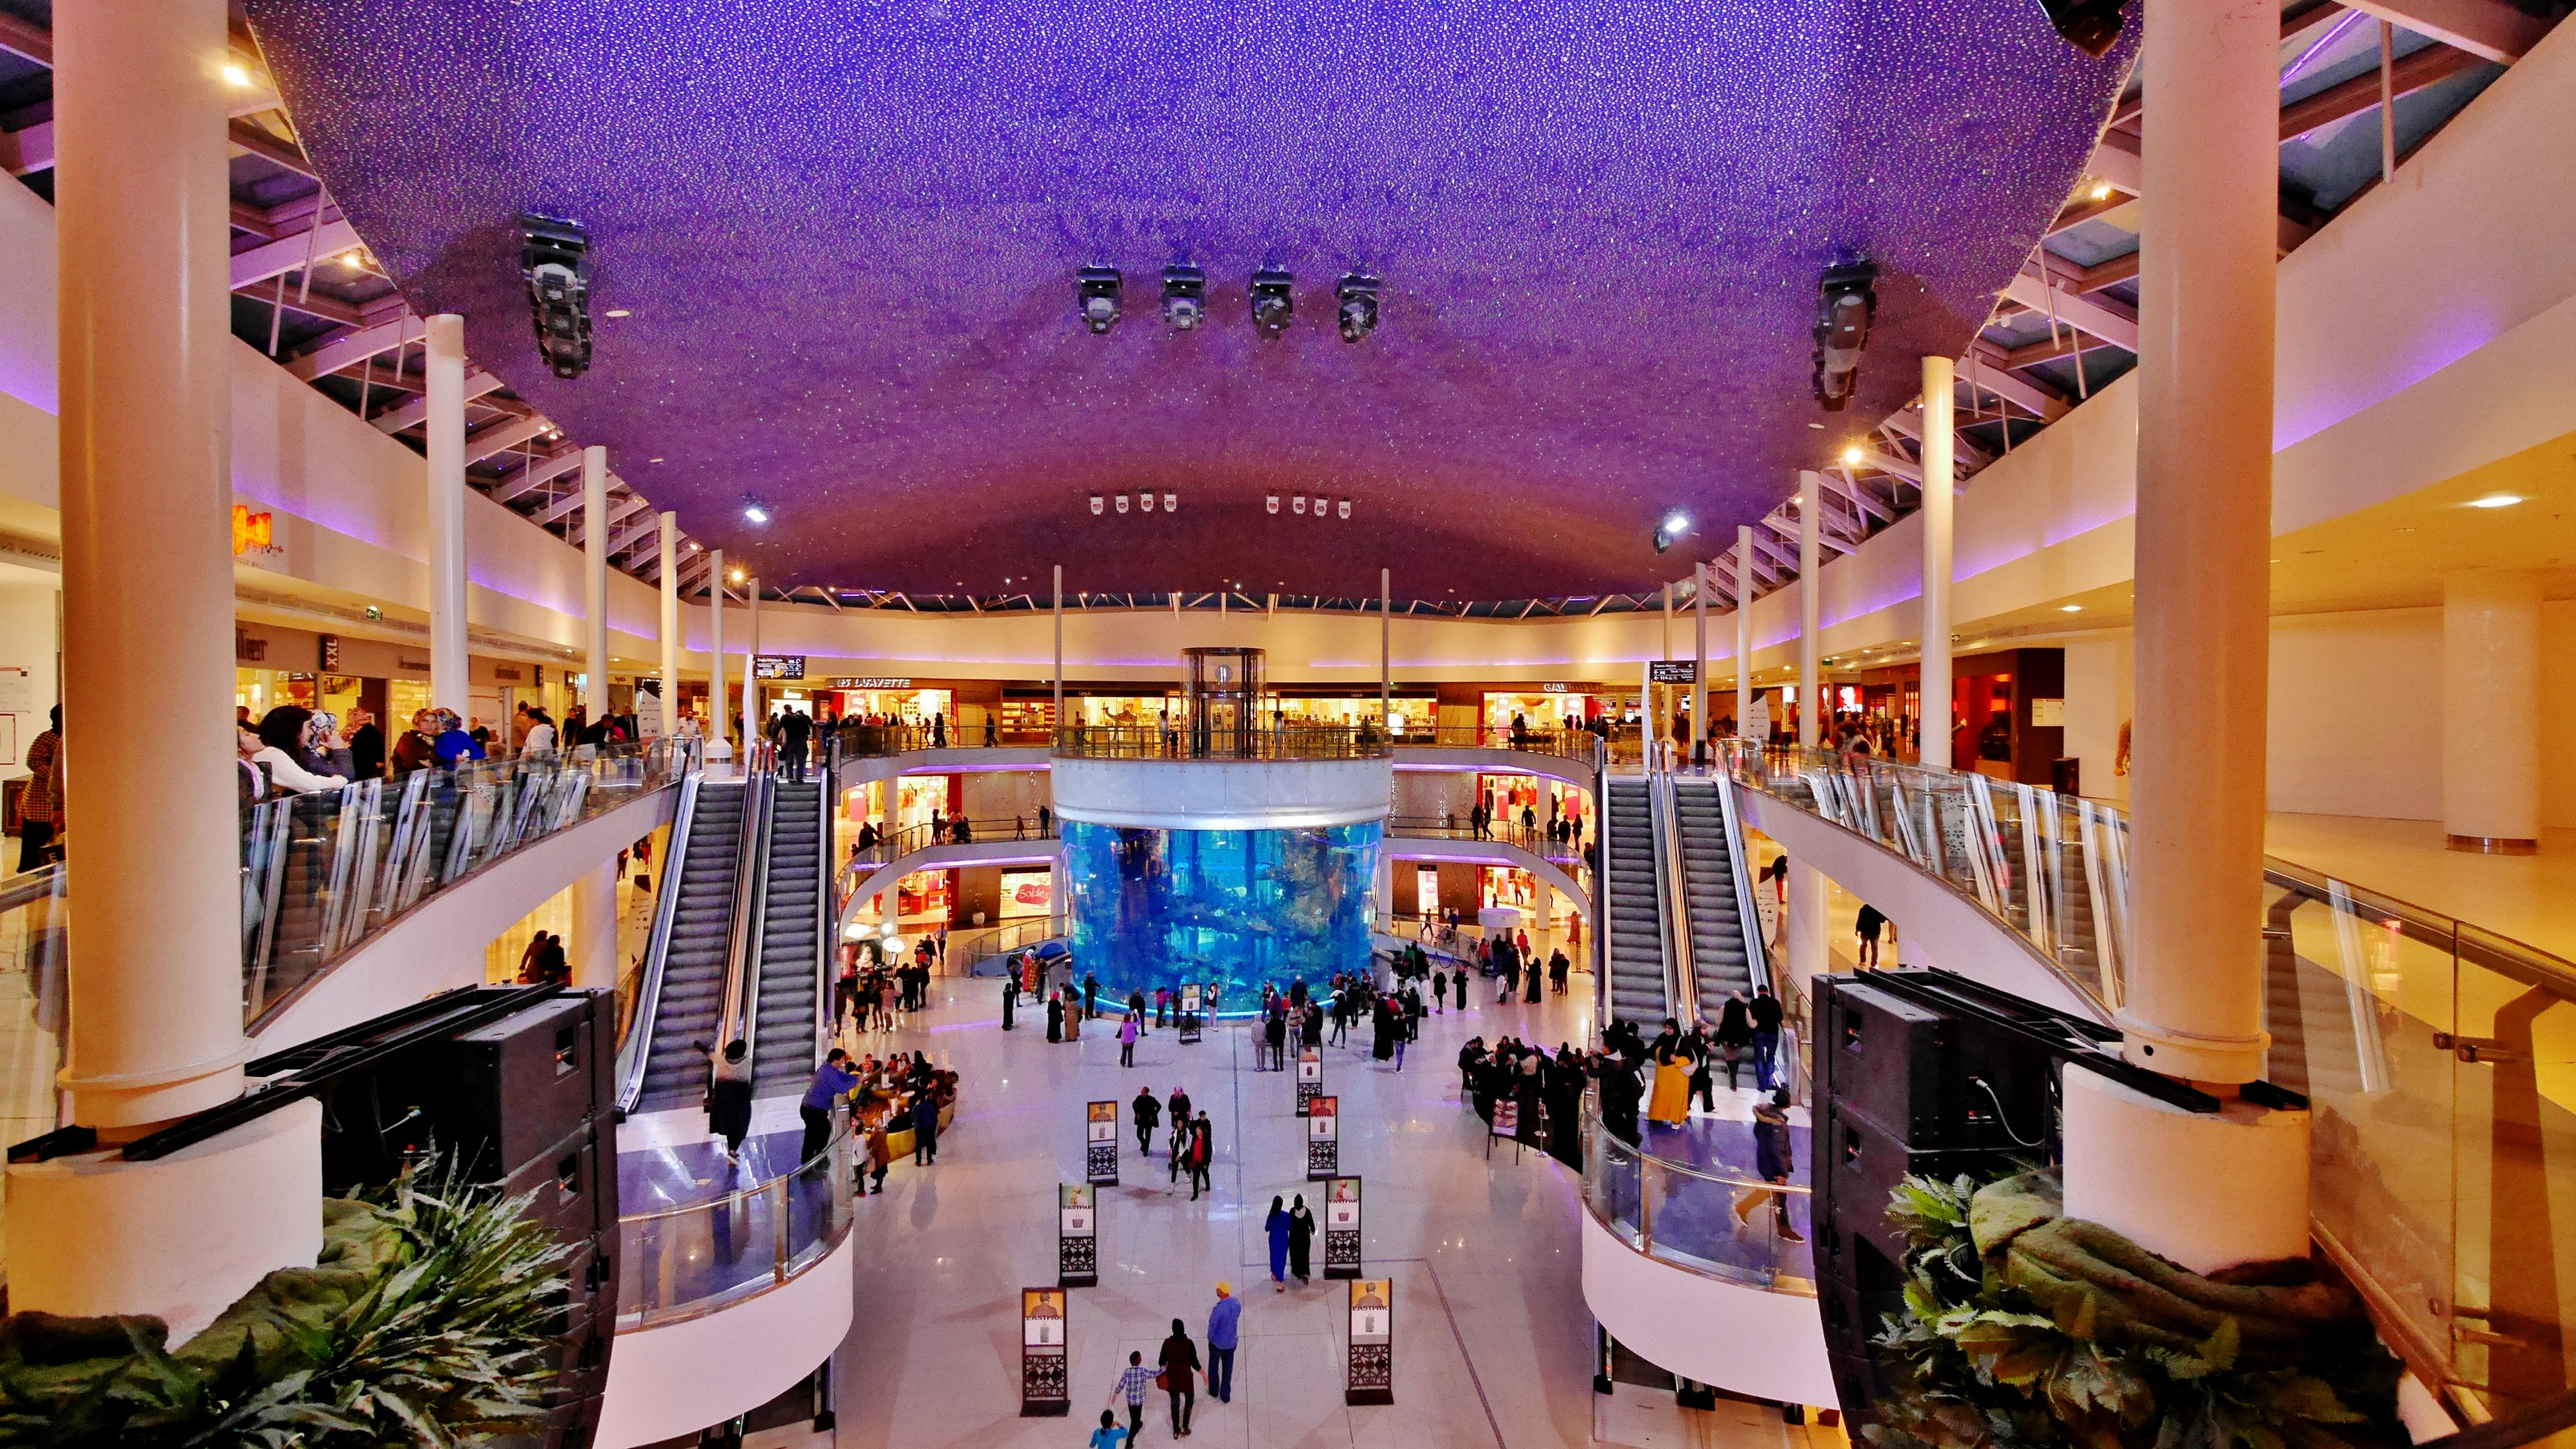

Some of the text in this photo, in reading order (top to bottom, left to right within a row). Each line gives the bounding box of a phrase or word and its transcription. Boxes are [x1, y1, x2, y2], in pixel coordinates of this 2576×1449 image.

[327, 639, 337, 666] XXL
[854, 678, 910, 687] LAFAYETTE
[1018, 888, 1050, 899] Soldes
